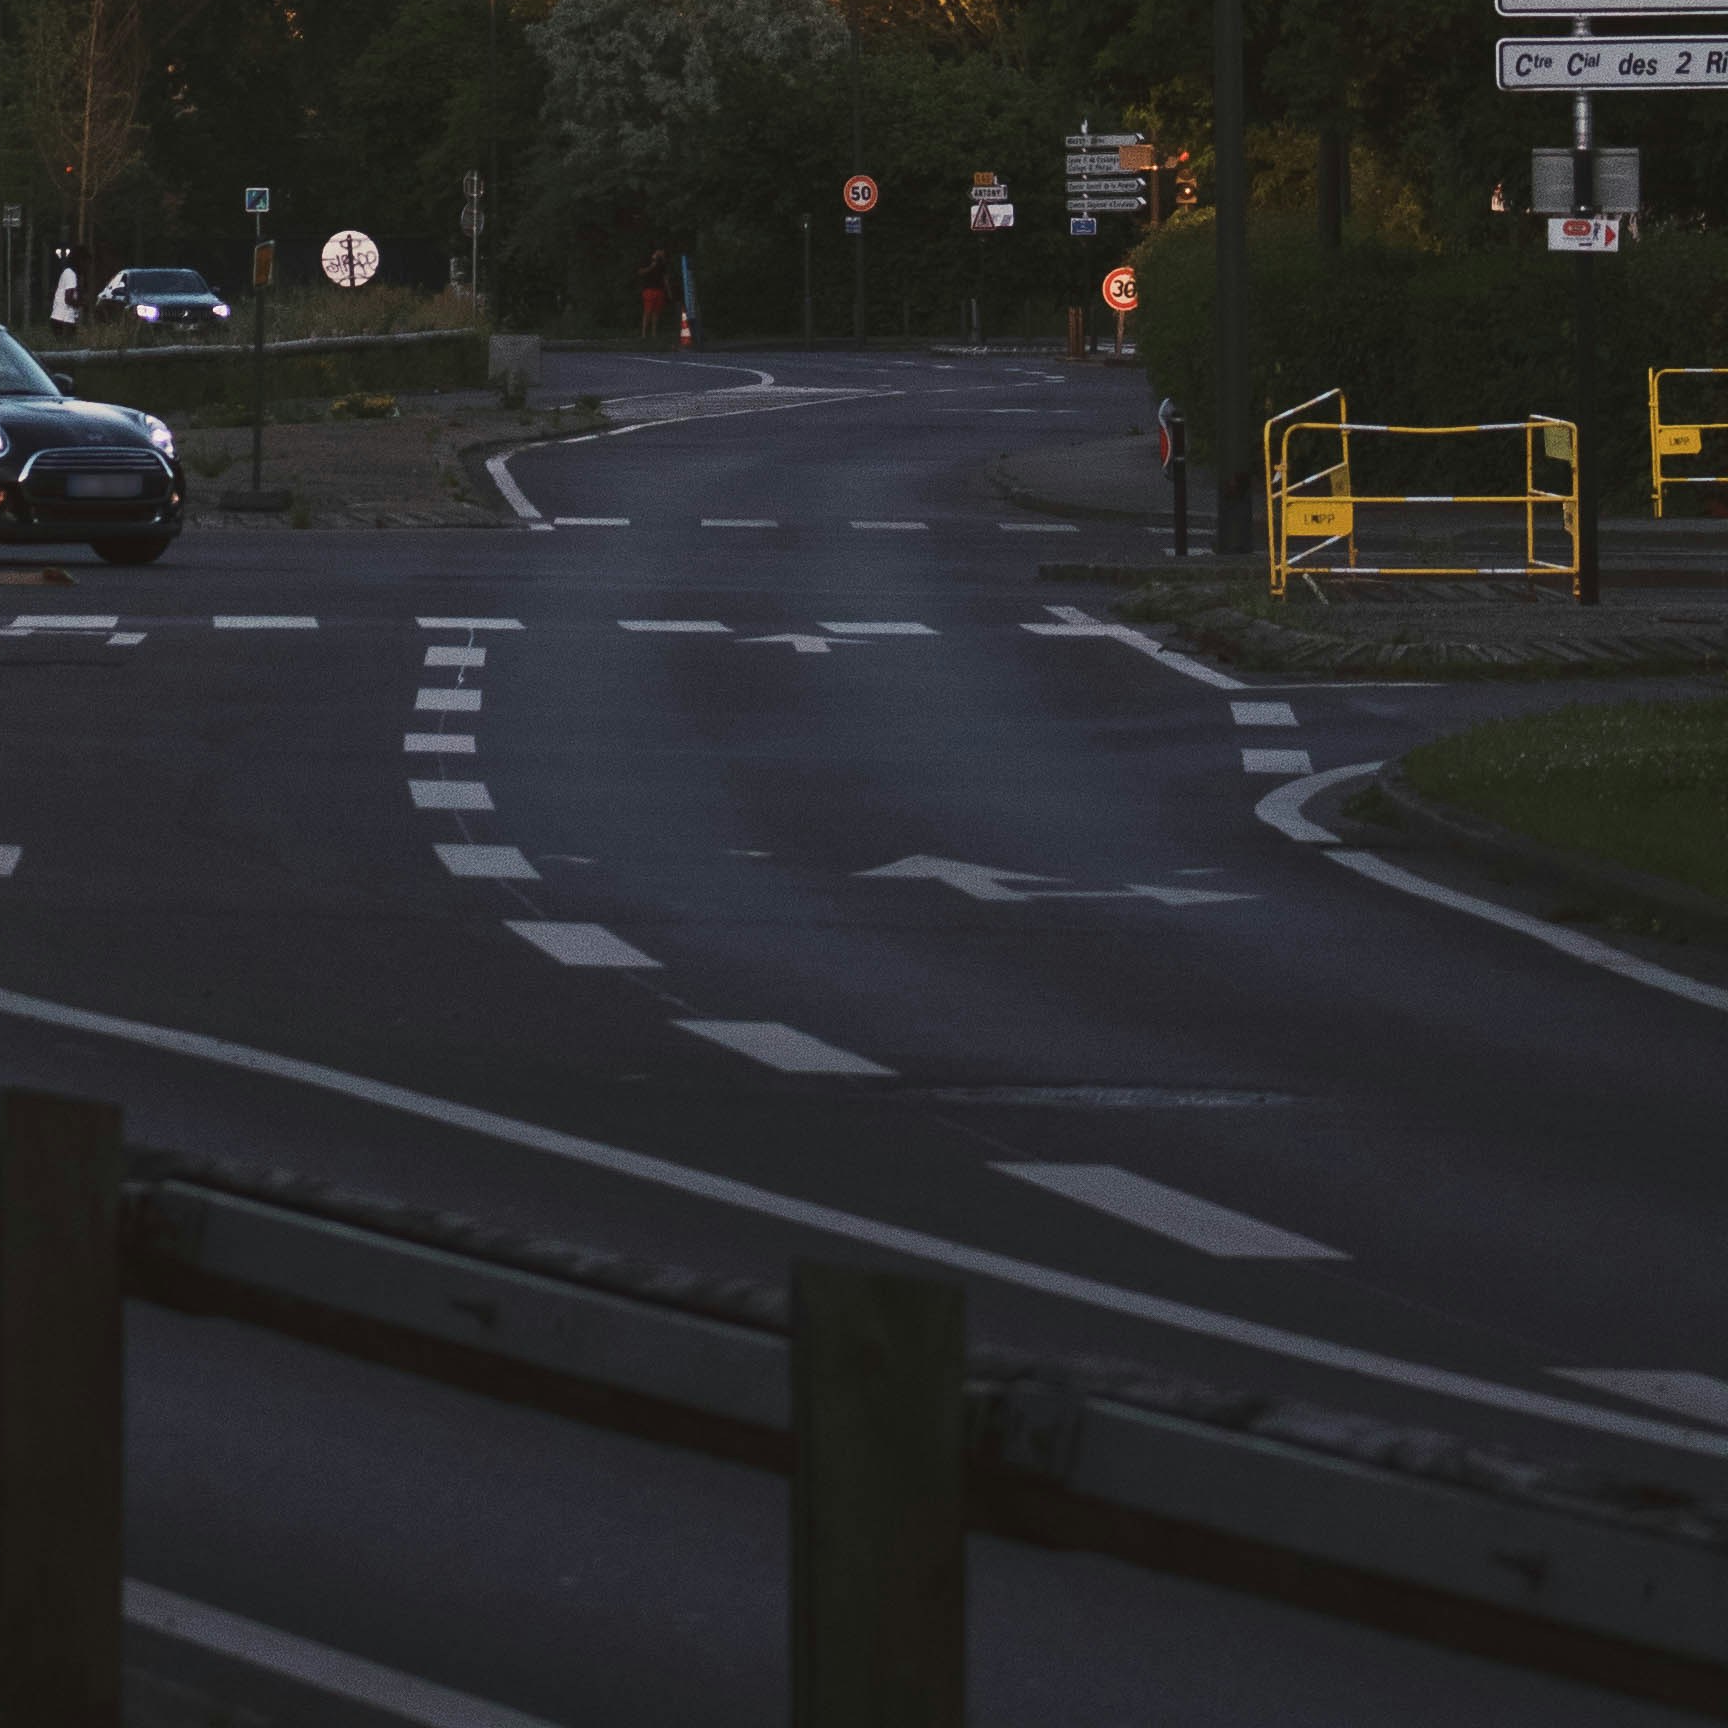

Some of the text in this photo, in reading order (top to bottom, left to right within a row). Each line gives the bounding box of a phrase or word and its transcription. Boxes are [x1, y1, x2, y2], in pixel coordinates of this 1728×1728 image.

[1515, 52, 1553, 77] Ctre
[1566, 52, 1601, 76] Cial
[1618, 52, 1658, 76] des
[1674, 51, 1692, 75] 2
[851, 185, 871, 201] 50
[1113, 279, 1136, 298] 30
